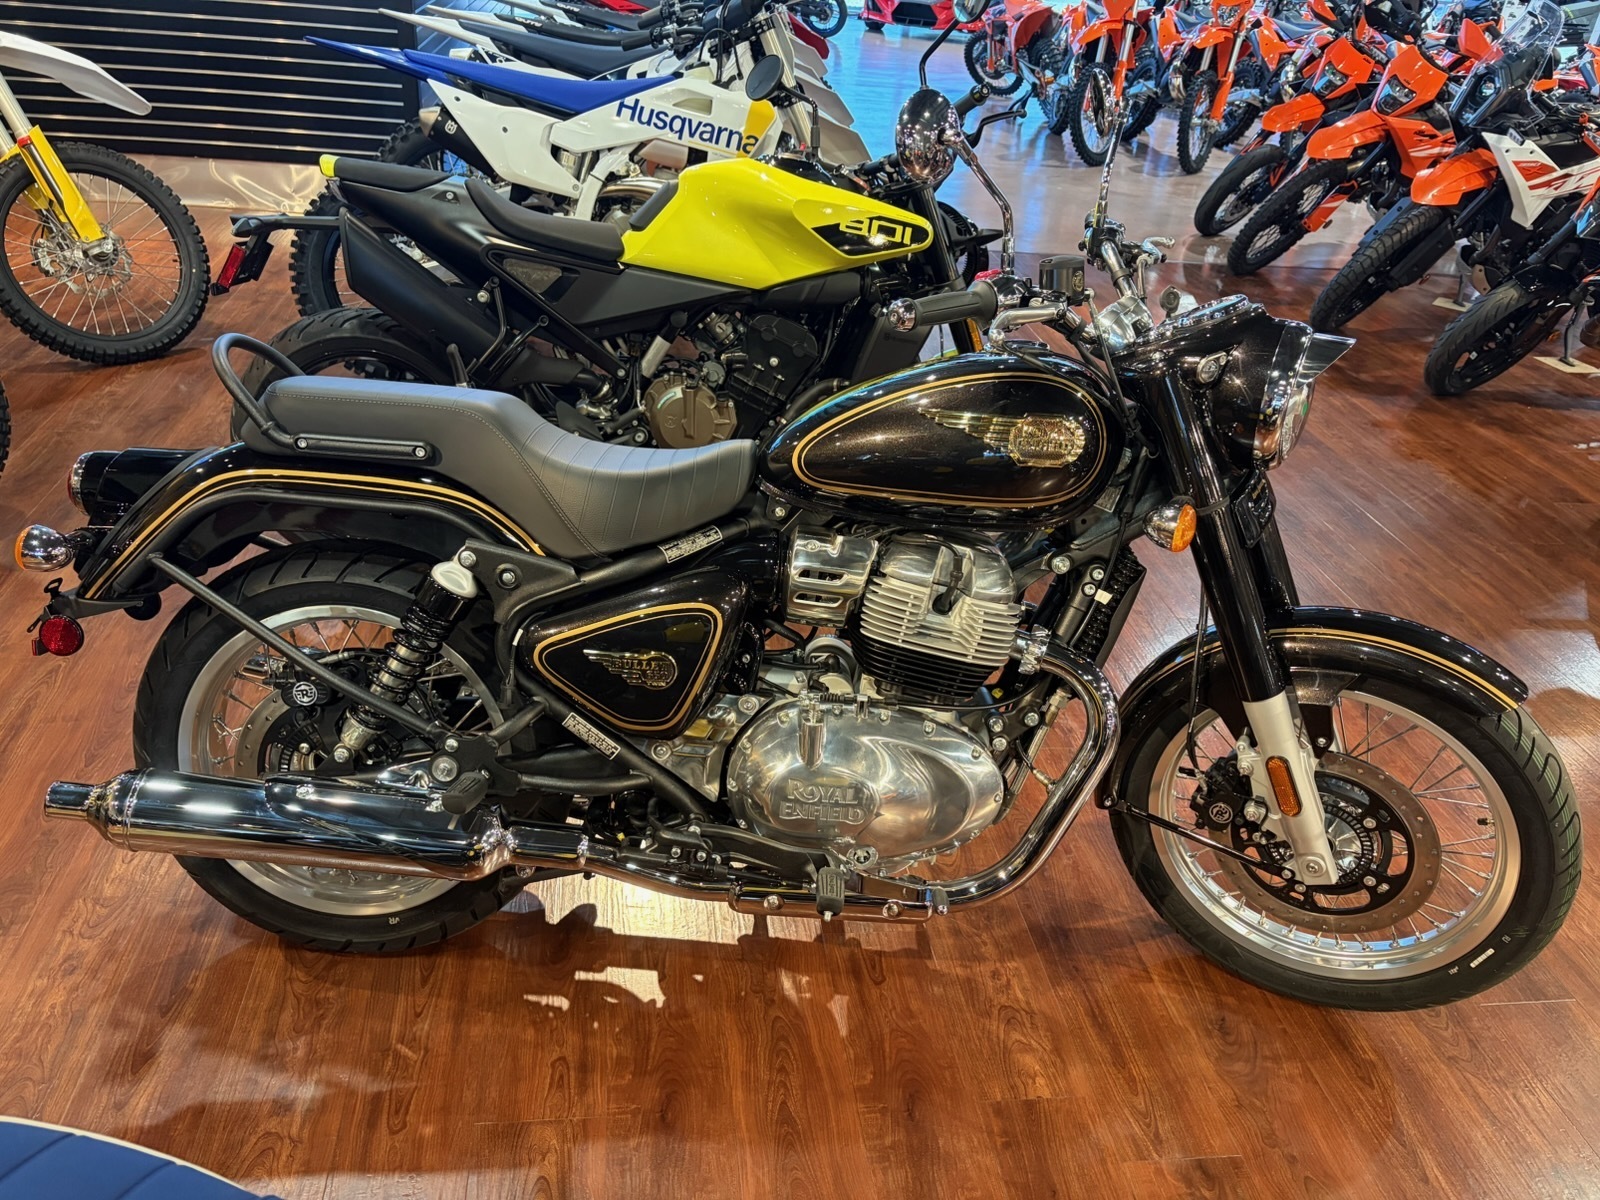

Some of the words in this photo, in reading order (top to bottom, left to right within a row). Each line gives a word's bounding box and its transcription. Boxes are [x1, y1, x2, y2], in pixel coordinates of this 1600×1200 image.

[616, 98, 760, 155] Husqvarna
[787, 778, 858, 804] ROYAL
[779, 801, 867, 825] ENFIELD
